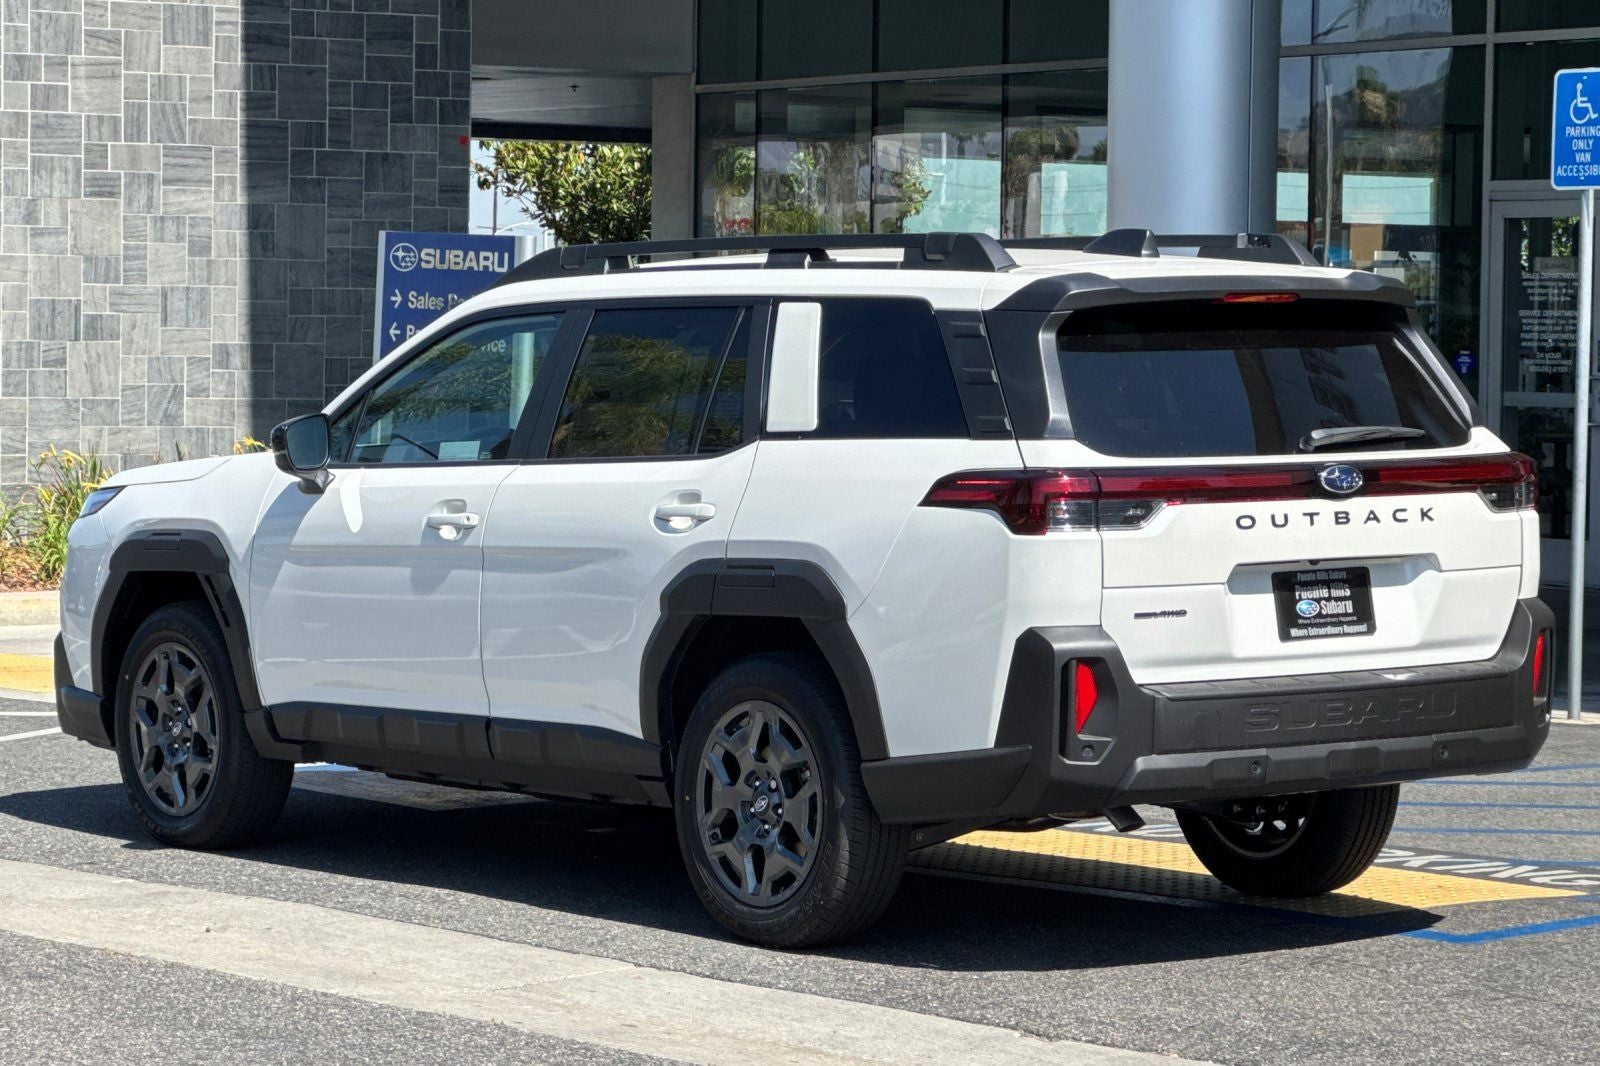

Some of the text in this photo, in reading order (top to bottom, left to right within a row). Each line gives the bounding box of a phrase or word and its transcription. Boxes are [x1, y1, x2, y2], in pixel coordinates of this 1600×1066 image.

[1566, 126, 1600, 137] PARKING
[1572, 139, 1594, 150] ONLY
[1575, 152, 1591, 162] VAN
[420, 248, 509, 273] SUBARU
[408, 290, 445, 311] Sales
[1236, 507, 1435, 530] OUTBACK
[1295, 581, 1351, 600] Puente Hills
[1320, 599, 1354, 615] Subaru
[1290, 628, 1309, 638] Where
[1308, 624, 1344, 636] Extraordinary
[1242, 691, 1458, 733] SUBARU
